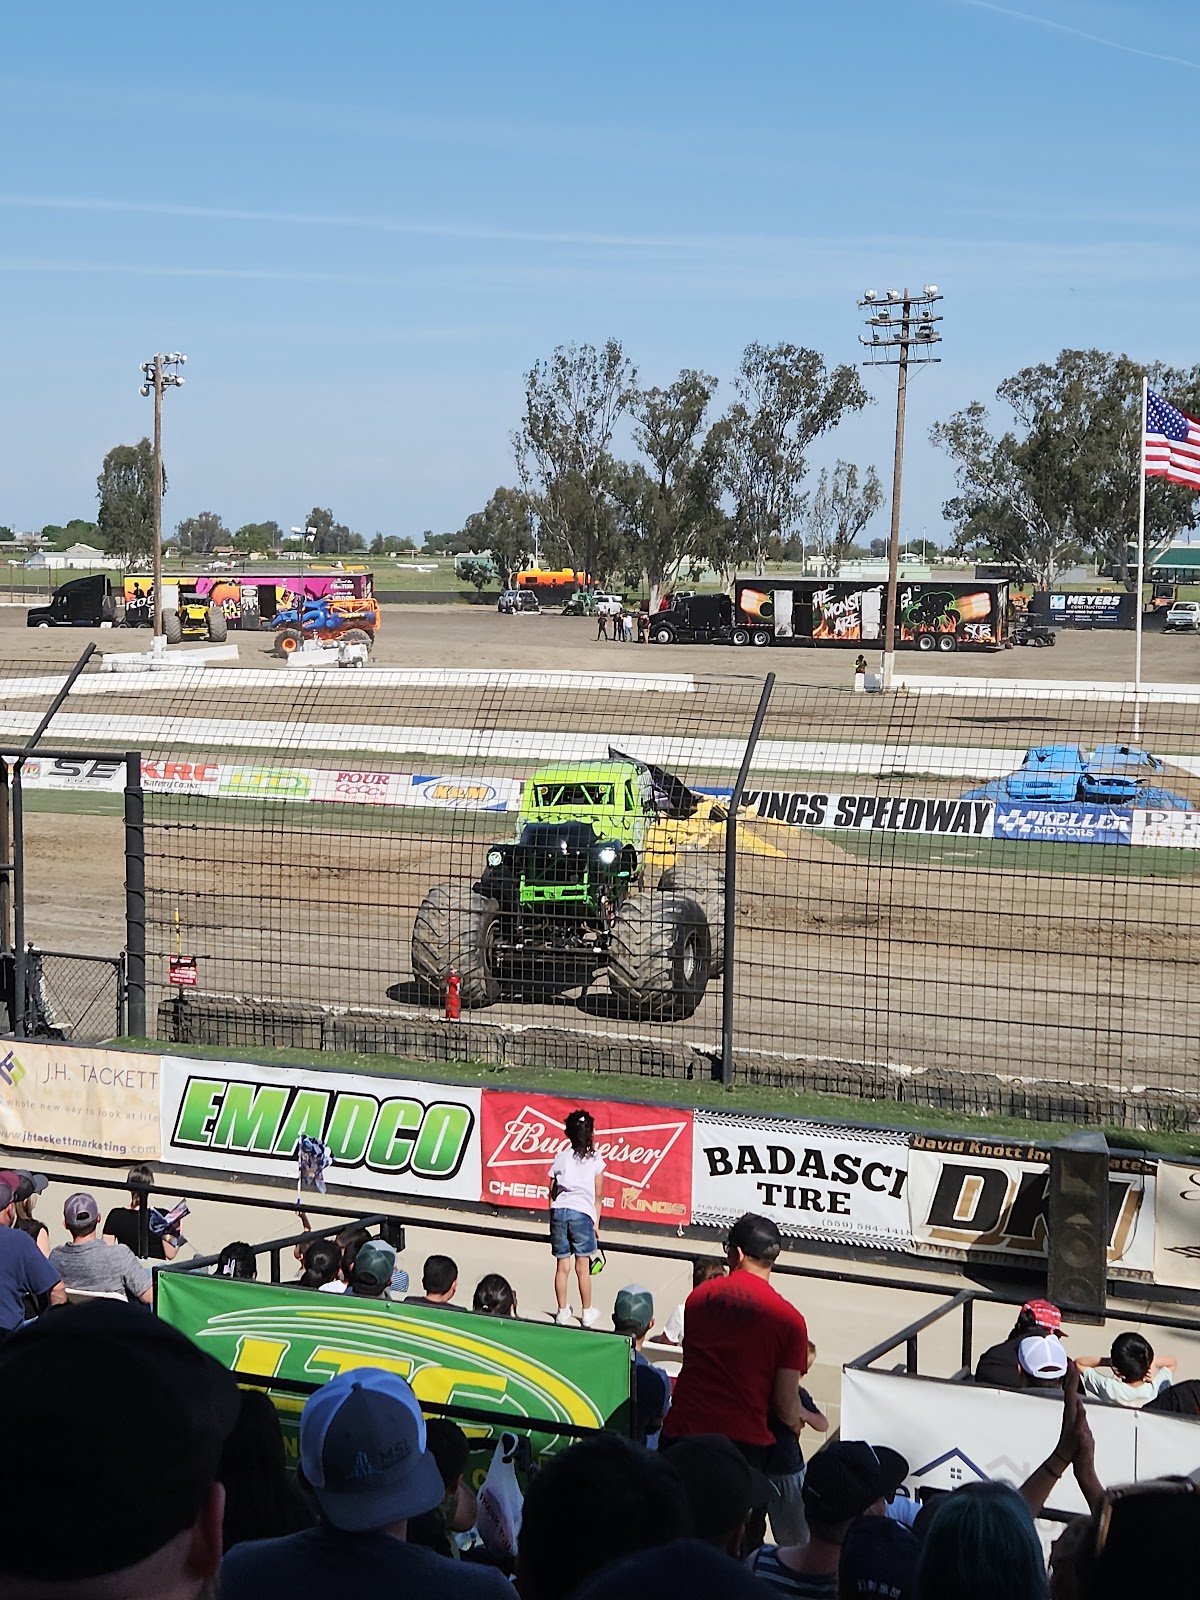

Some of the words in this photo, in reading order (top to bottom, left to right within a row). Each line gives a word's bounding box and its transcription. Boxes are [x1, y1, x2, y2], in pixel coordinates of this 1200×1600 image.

[1067, 595, 1121, 605] MEYERS
[833, 613, 861, 635] ARE
[140, 761, 219, 782] KRC
[335, 773, 389, 785] FOUR
[834, 796, 994, 835] SPEEDWAY
[1024, 810, 1131, 831] KELLER
[1033, 826, 1095, 837] MOTORS
[43, 1062, 71, 1084] J.H.
[80, 1064, 159, 1090] TACKETT
[6, 1099, 36, 1109] whole
[65, 1106, 82, 1115] way
[86, 1107, 95, 1116] to
[98, 1108, 121, 1119] look
[125, 1112, 136, 1120] at
[139, 1112, 160, 1122] life
[171, 1075, 475, 1181] EMADCO
[504, 1120, 664, 1166] Bueiser
[912, 1134, 965, 1152] David
[969, 1141, 1023, 1159] Knott
[702, 1145, 908, 1199] BADASCI
[621, 1188, 687, 1215] KINGS
[697, 1203, 751, 1215] HANFOR
[756, 1181, 851, 1216] TIRE
